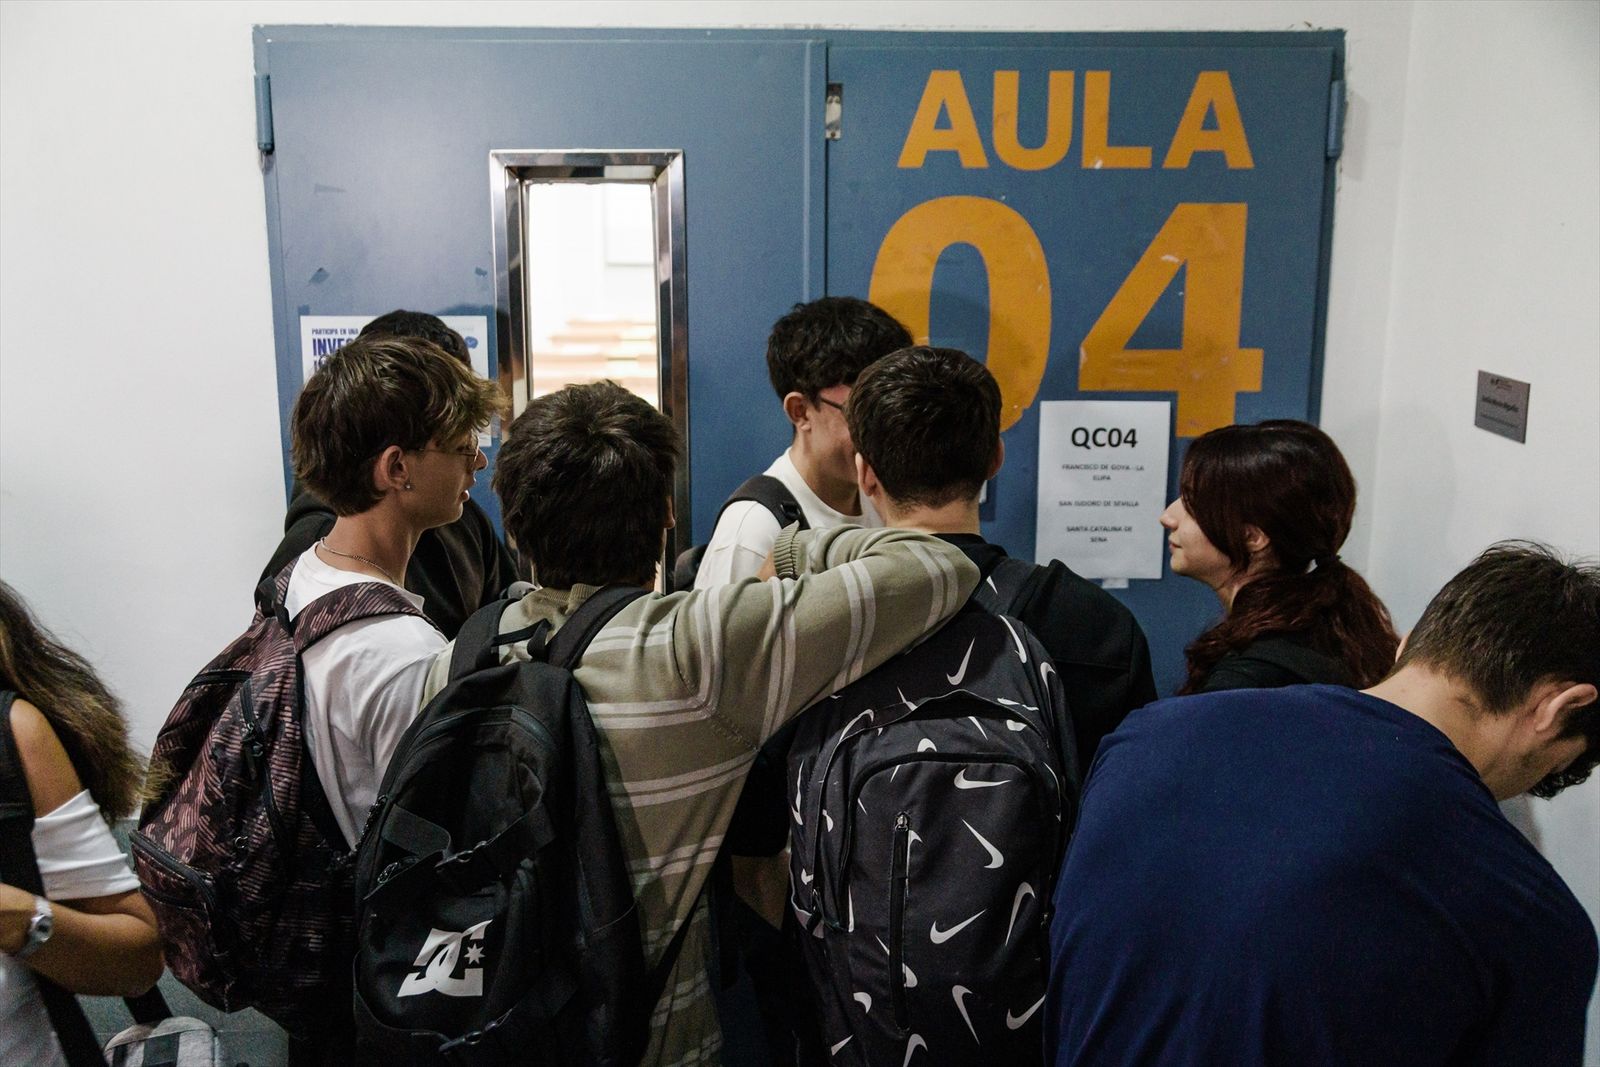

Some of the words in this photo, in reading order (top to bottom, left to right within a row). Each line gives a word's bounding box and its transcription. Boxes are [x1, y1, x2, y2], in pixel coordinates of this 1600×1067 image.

[897, 70, 1254, 171] AULA
[868, 195, 1264, 438] 04
[1071, 427, 1138, 450] QC04
[1062, 463, 1099, 471] FRANCISCO
[1113, 500, 1139, 508] SEVILLA
